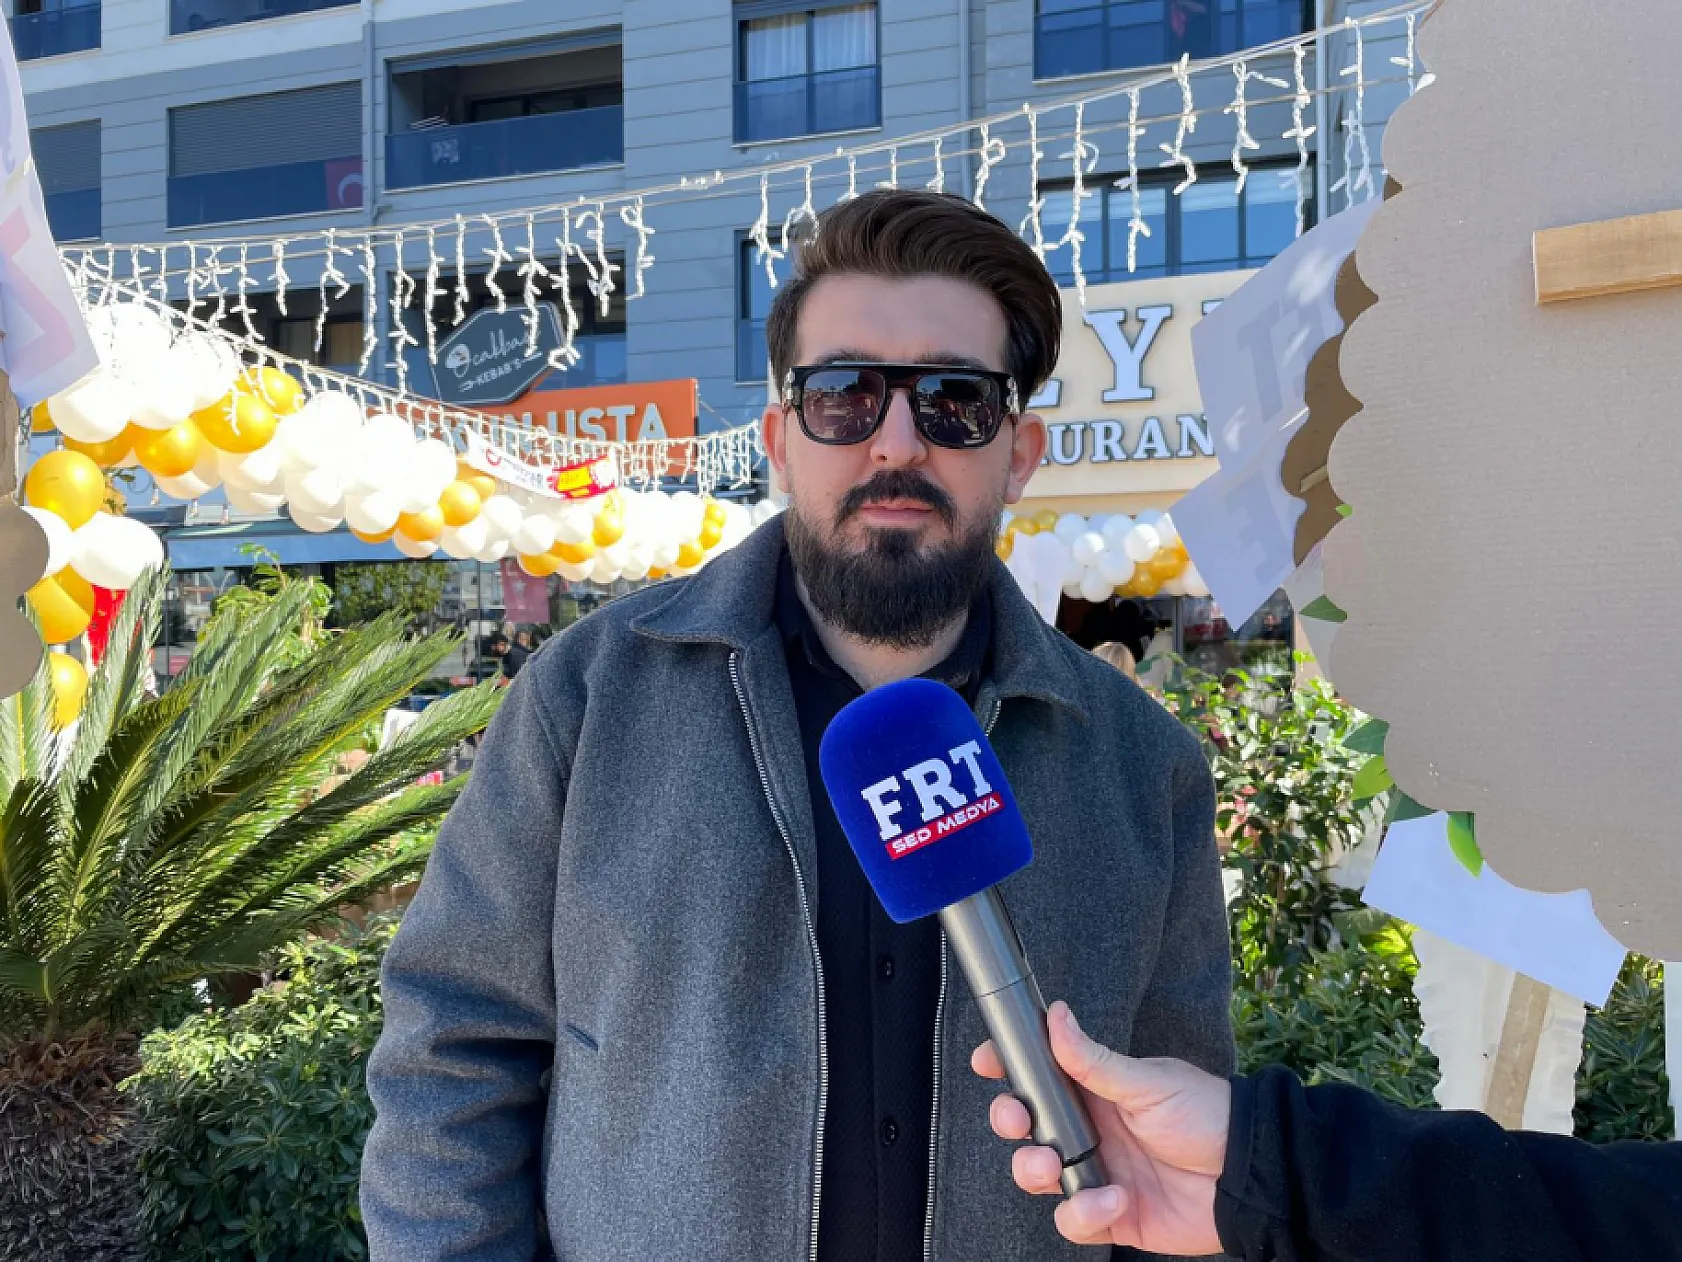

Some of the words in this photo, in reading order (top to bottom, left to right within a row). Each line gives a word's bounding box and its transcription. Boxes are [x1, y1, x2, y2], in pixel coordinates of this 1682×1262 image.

[476, 358, 522, 386] KEBAB'S
[547, 402, 668, 454] USTA
[1042, 415, 1215, 466] URAN
[861, 739, 992, 841] FRT
[892, 827, 932, 853] SED
[937, 797, 1000, 834] MEDYA
